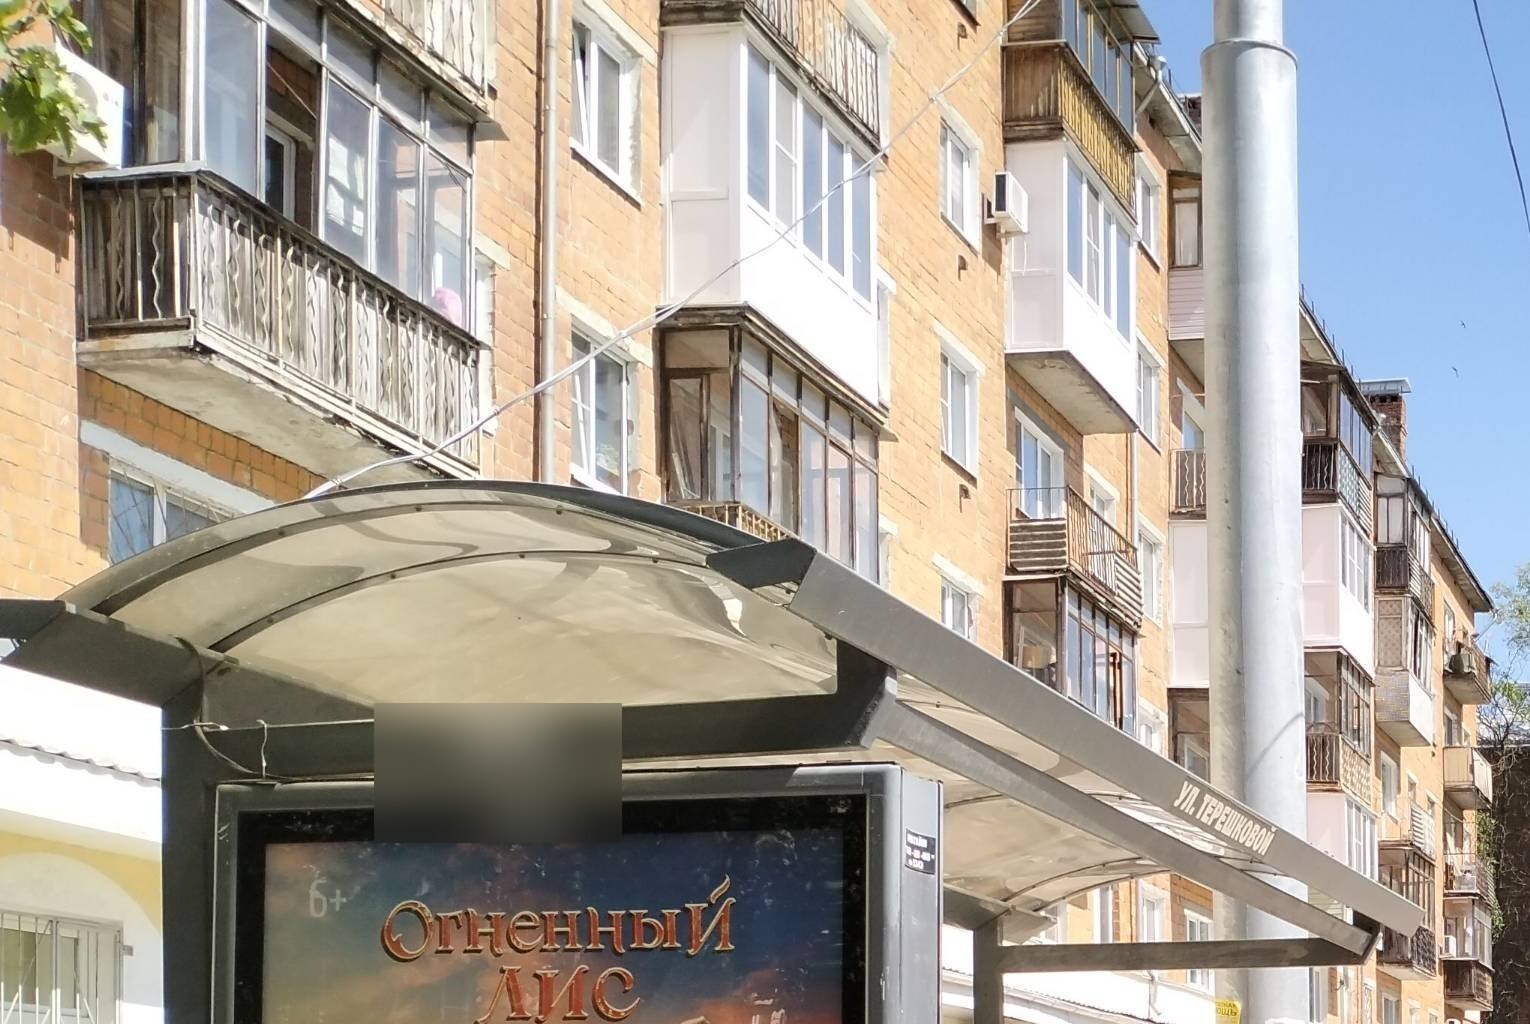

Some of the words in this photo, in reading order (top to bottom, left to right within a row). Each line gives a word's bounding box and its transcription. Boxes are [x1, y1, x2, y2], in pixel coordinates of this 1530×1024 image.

[1173, 781, 1200, 816] УЛ.
[1196, 793, 1277, 856] ТЕРЕШКОВОЙ
[309, 879, 347, 917] 6+
[381, 874, 737, 961] Огненный
